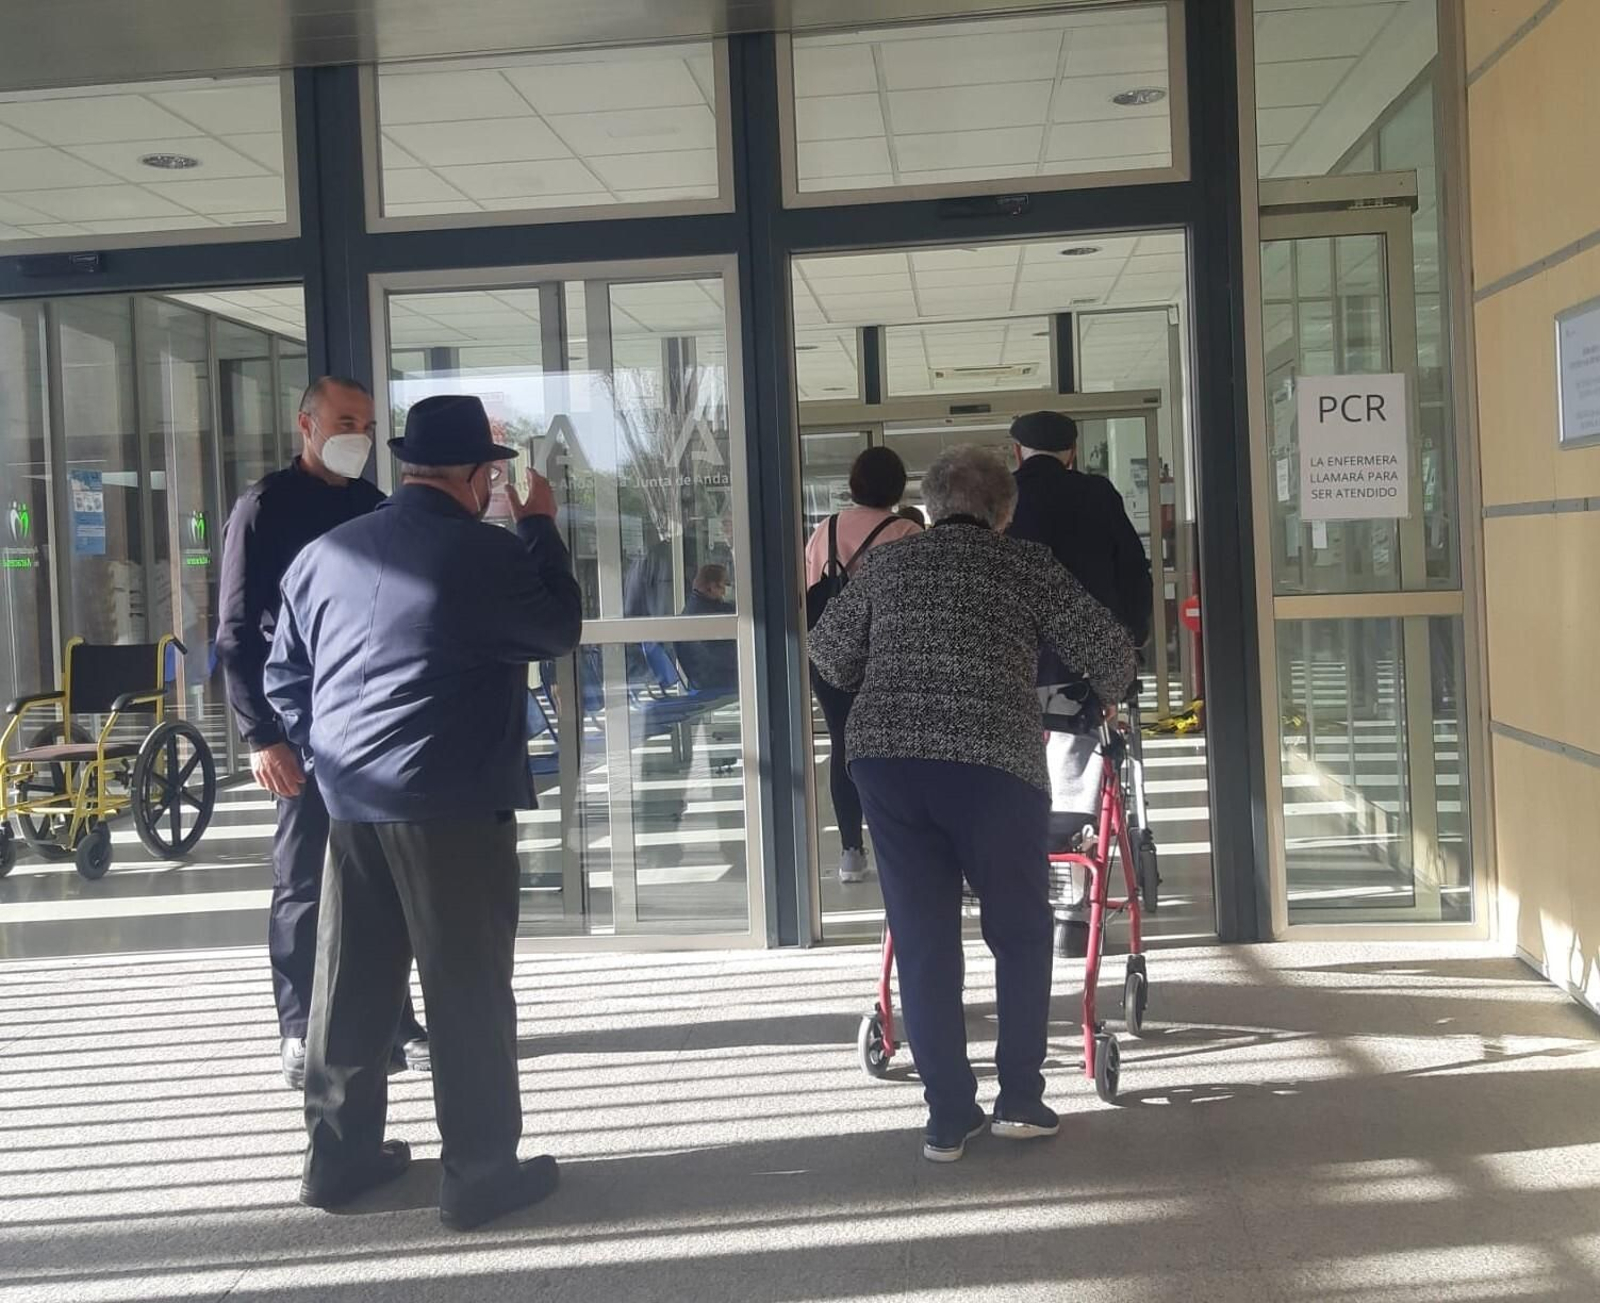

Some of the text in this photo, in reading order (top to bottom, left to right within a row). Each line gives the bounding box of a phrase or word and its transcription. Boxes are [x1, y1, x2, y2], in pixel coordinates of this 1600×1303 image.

[1318, 394, 1387, 424] PCR
[1310, 455, 1398, 468] LA ENFERMERA
[676, 473, 691, 487] de
[1310, 470, 1399, 484] LLAMARÁ PARA
[1310, 487, 1398, 499] SER ATENDIDO
